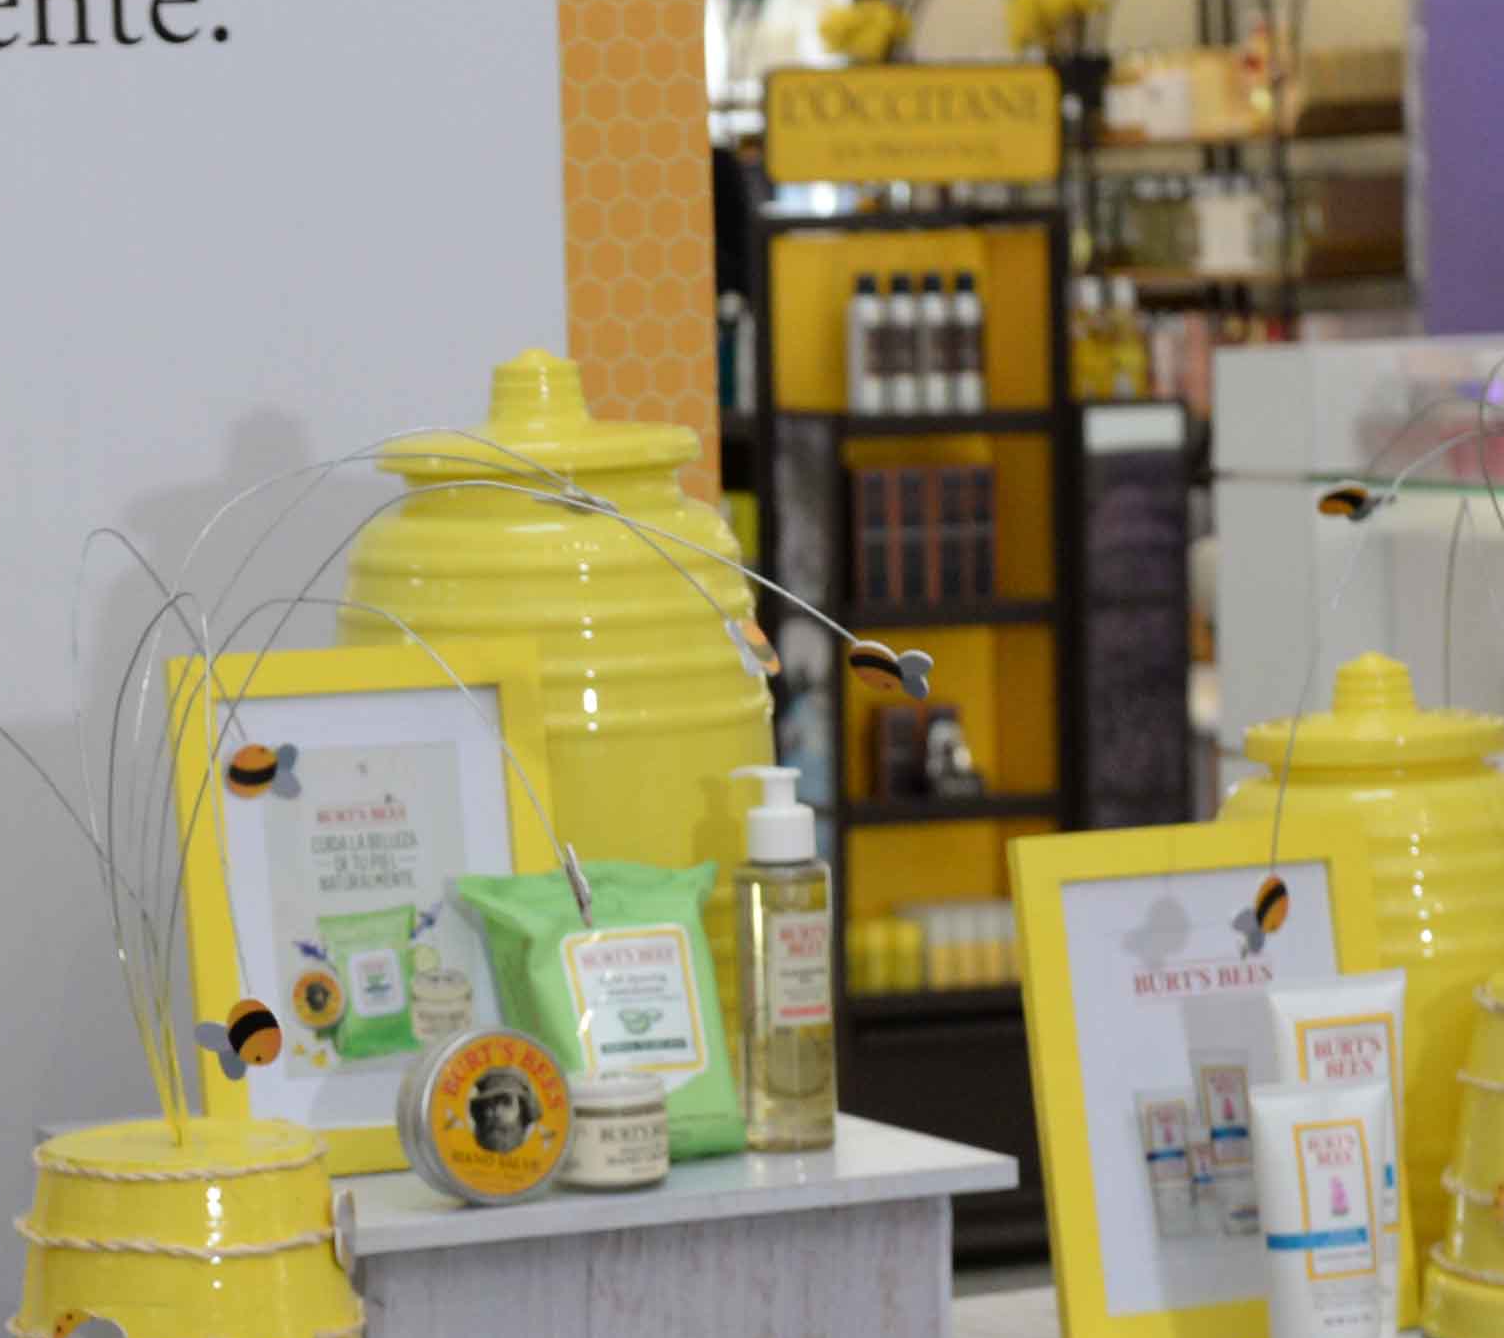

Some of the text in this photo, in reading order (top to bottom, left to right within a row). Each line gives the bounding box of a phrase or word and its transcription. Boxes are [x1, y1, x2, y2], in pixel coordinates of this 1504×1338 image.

[778, 79, 1042, 129] L'OCCITANE
[1134, 963, 1274, 995] BURT'S BEES
[1313, 1036, 1383, 1059] BURT'S
